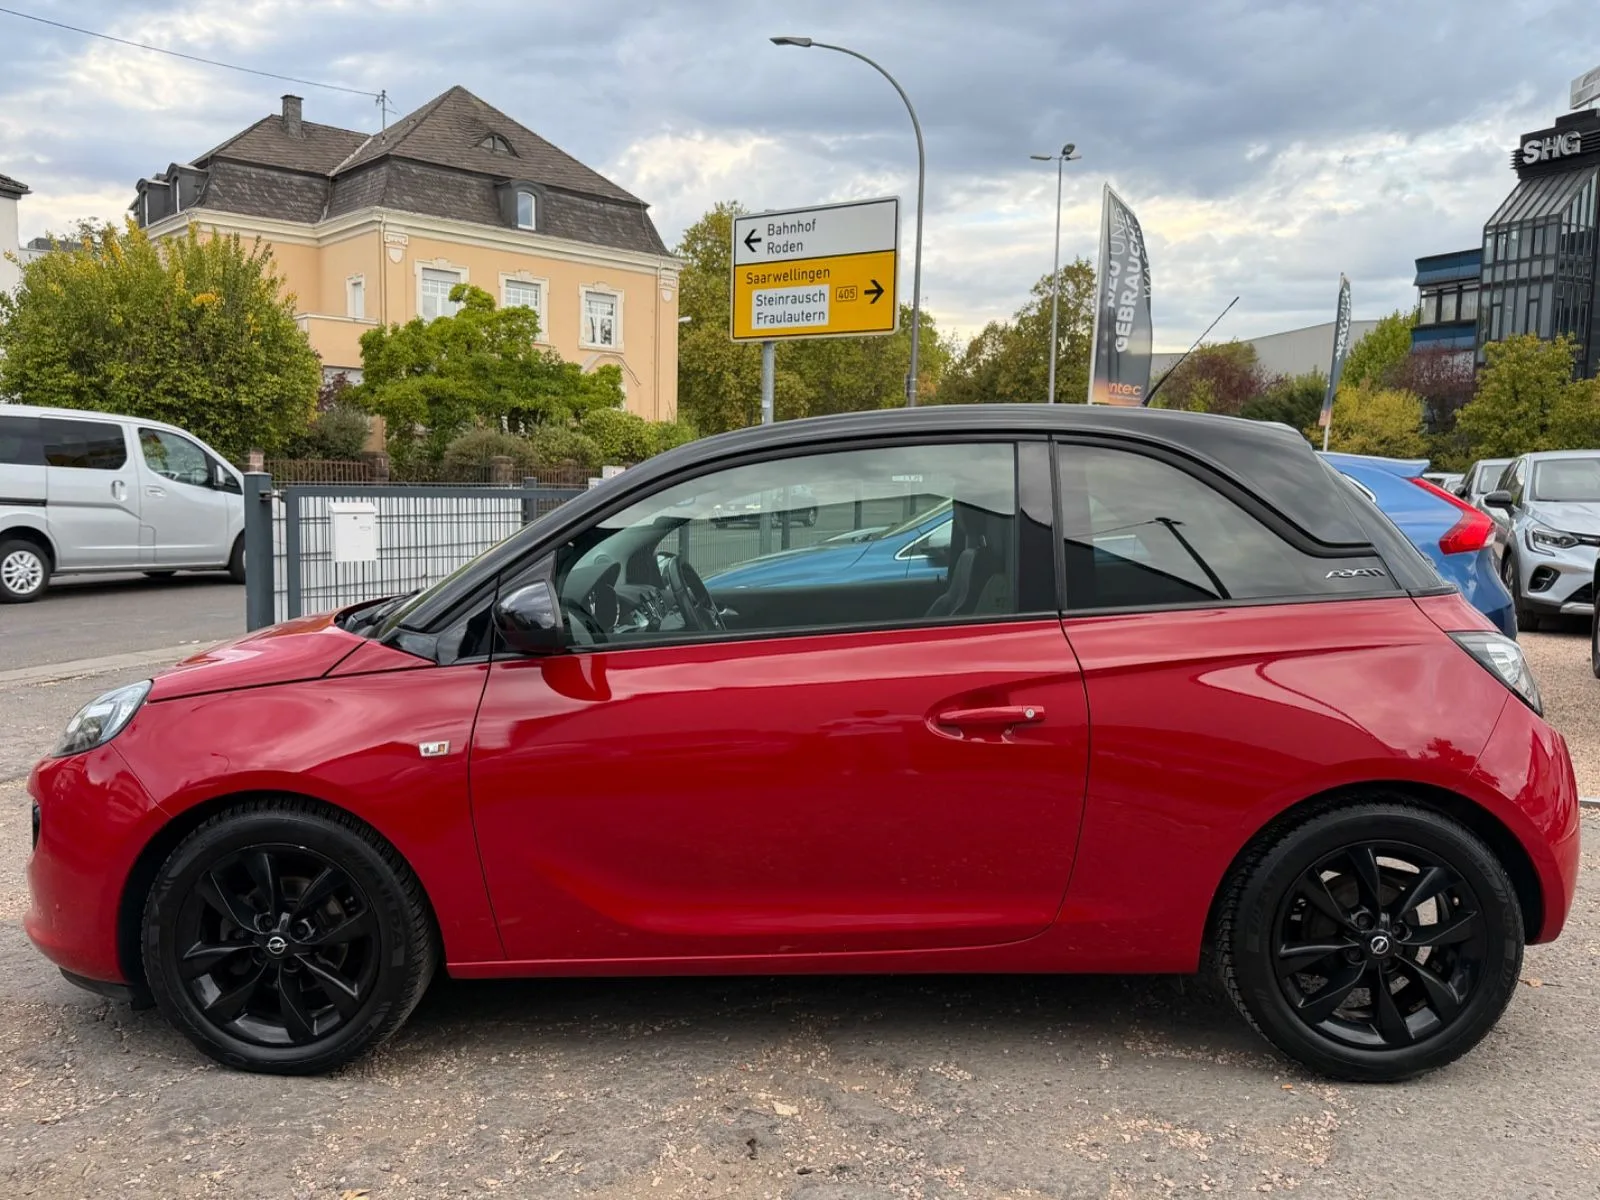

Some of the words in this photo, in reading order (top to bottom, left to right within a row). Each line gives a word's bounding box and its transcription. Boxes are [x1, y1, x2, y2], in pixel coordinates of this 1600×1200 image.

[1522, 130, 1582, 165] SHG
[767, 218, 817, 237] Bahnhof
[767, 241, 804, 255] Roden
[746, 267, 831, 285] Saarwellingen
[756, 289, 826, 308] Steinrausch
[838, 287, 856, 301] 405
[756, 309, 826, 325] Fraulautern
